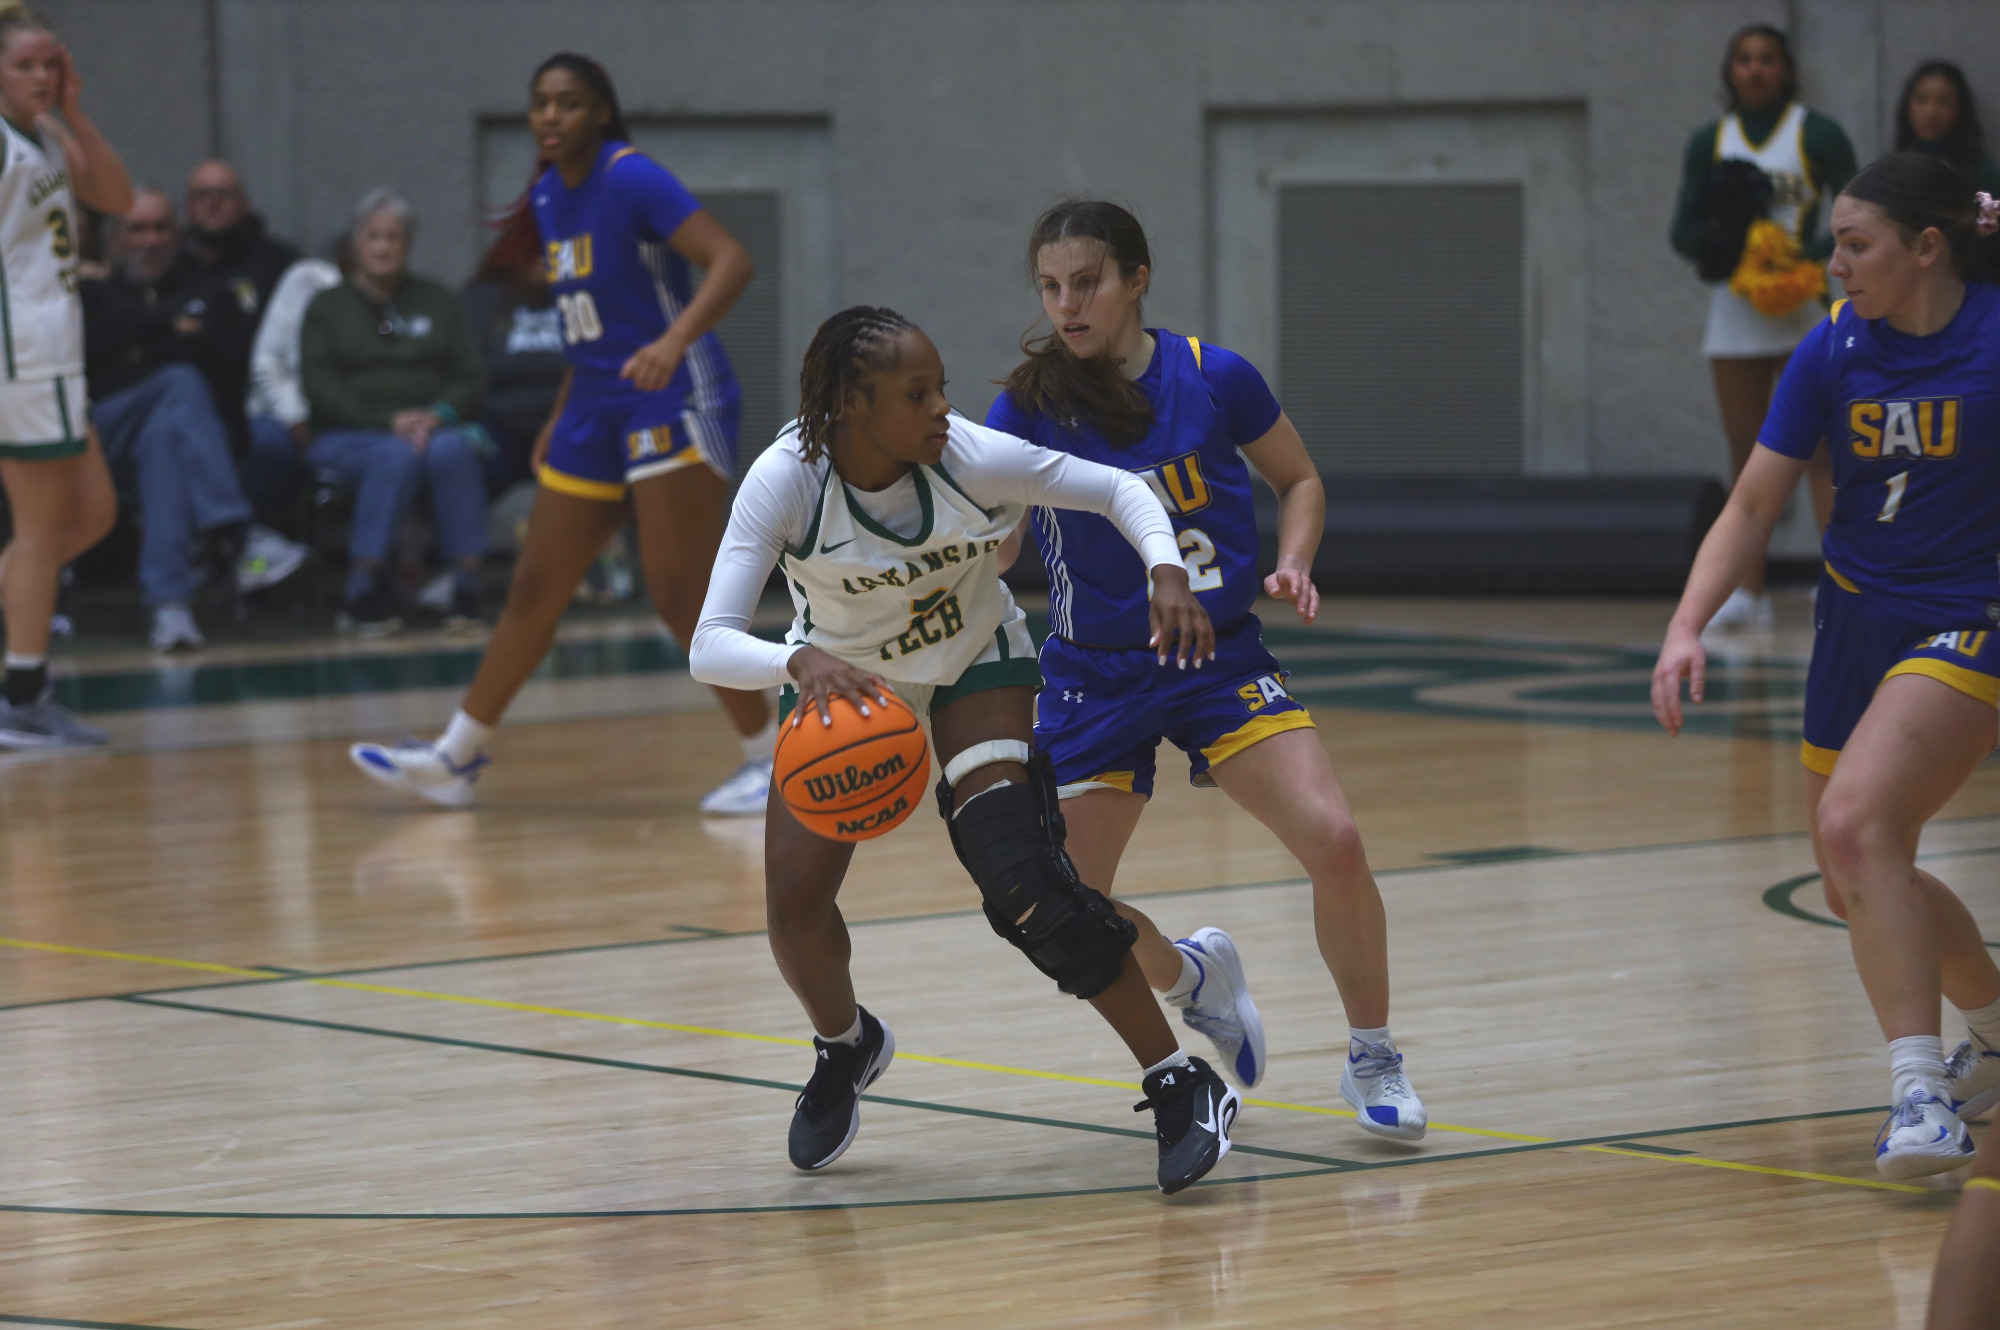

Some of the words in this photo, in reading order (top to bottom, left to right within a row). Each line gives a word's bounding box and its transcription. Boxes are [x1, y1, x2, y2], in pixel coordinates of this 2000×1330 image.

[546, 233, 593, 284] SAU
[628, 424, 673, 461] SAU
[1849, 399, 1959, 458] SAU
[1136, 455, 1209, 514] AU
[1876, 470, 1909, 523] 1
[803, 753, 907, 804] Wilson
[836, 794, 910, 835] NCAA
